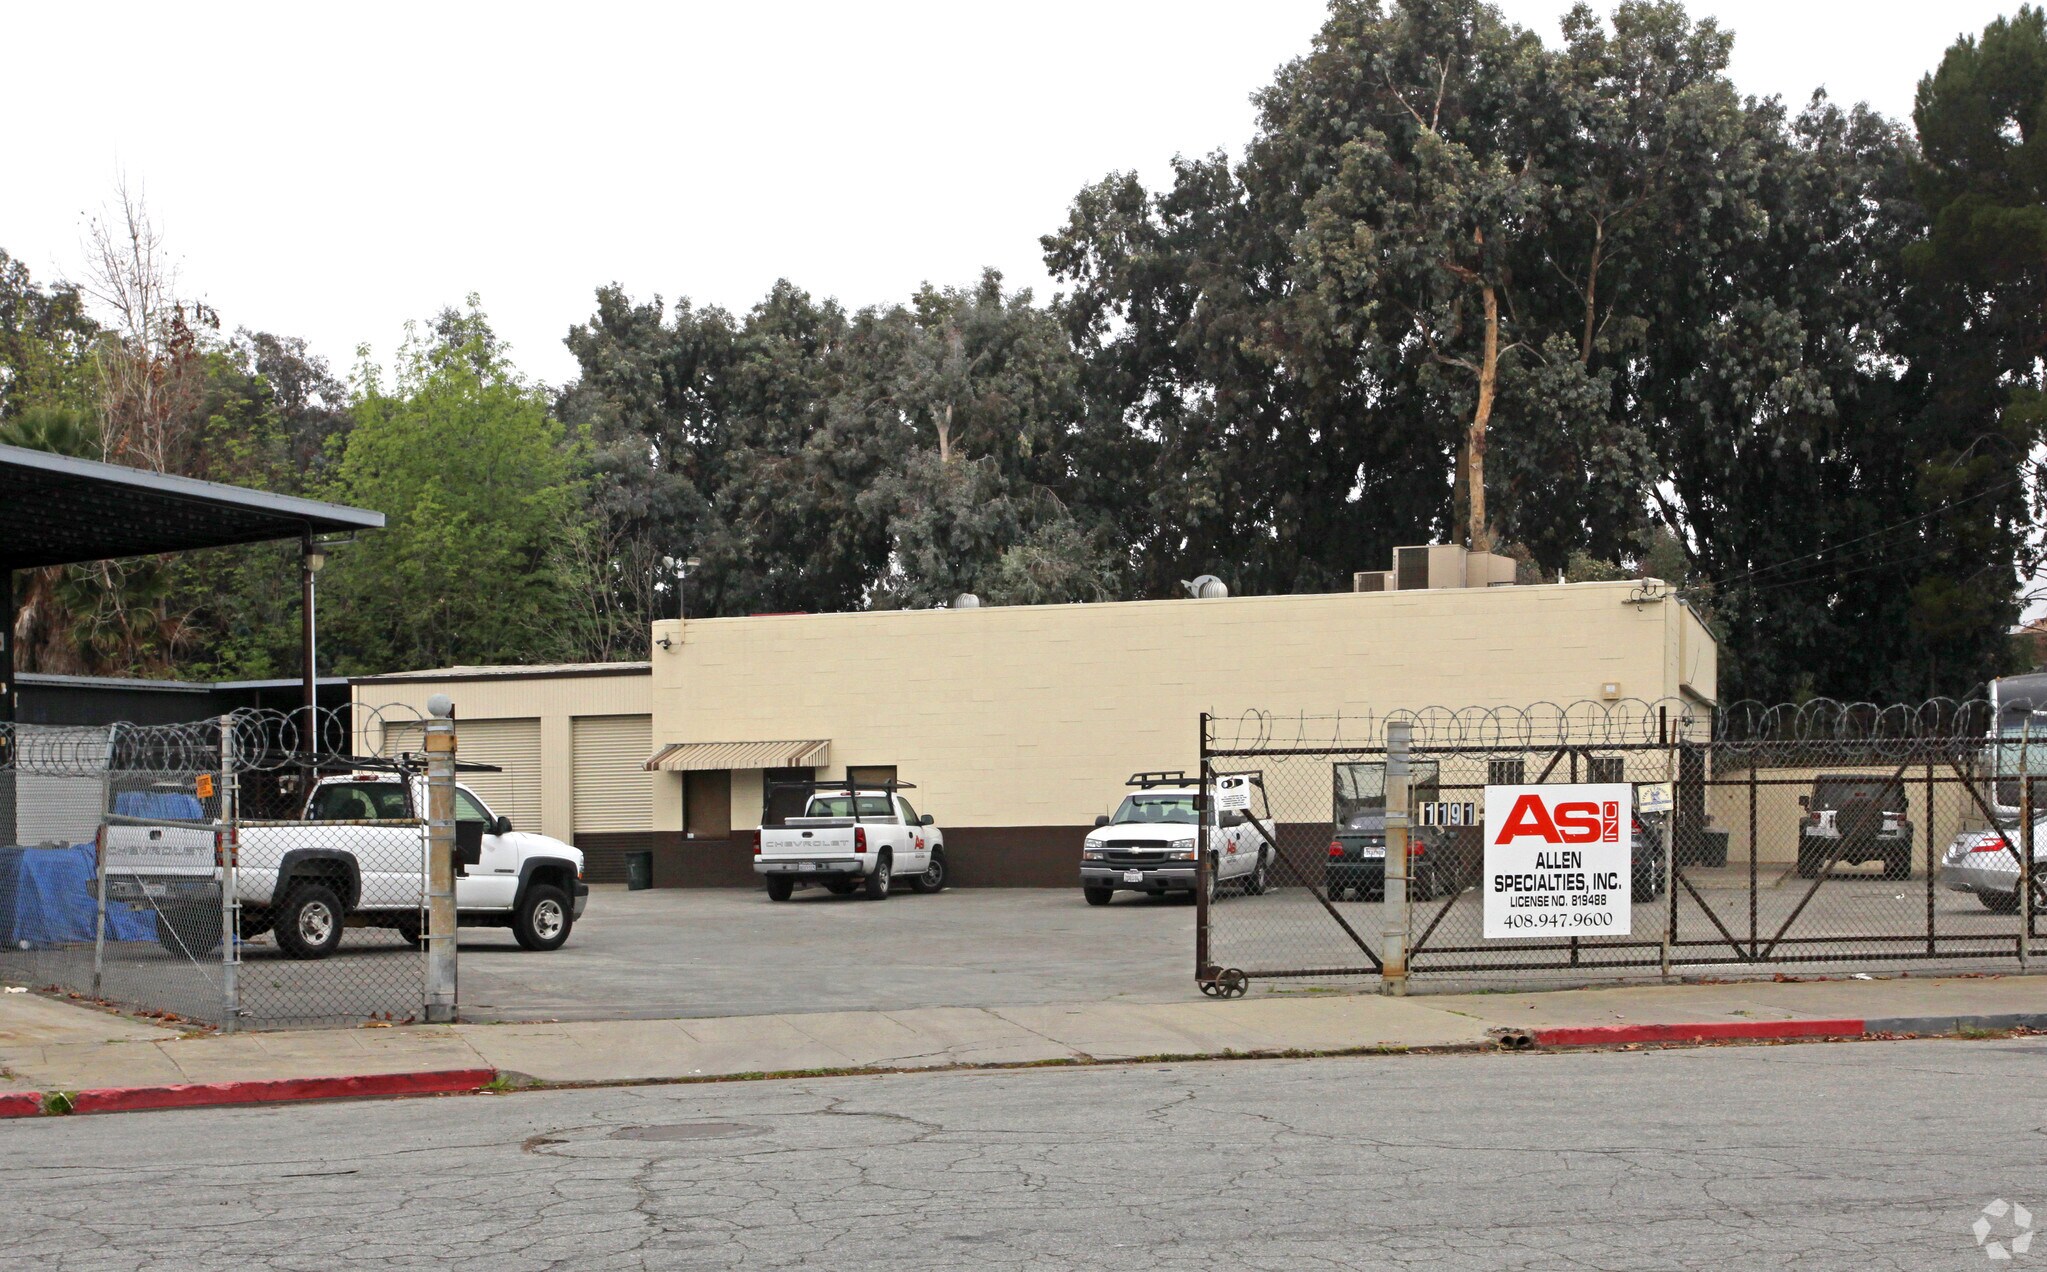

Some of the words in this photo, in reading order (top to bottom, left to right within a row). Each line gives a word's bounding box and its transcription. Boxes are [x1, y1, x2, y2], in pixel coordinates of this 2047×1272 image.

[1425, 803, 1473, 825] 1191
[1604, 803, 1617, 841] INC
[765, 839, 850, 848] CHEVROLET
[1535, 851, 1582, 869] ALLEN
[1494, 873, 1589, 894] SPECIALTIES,
[1593, 872, 1622, 890] INC.
[1510, 895, 1550, 908] LICENSE
[1551, 895, 1568, 907] NO.
[1571, 894, 1607, 906] 819488
[1503, 912, 1613, 929] 408.947.9600
